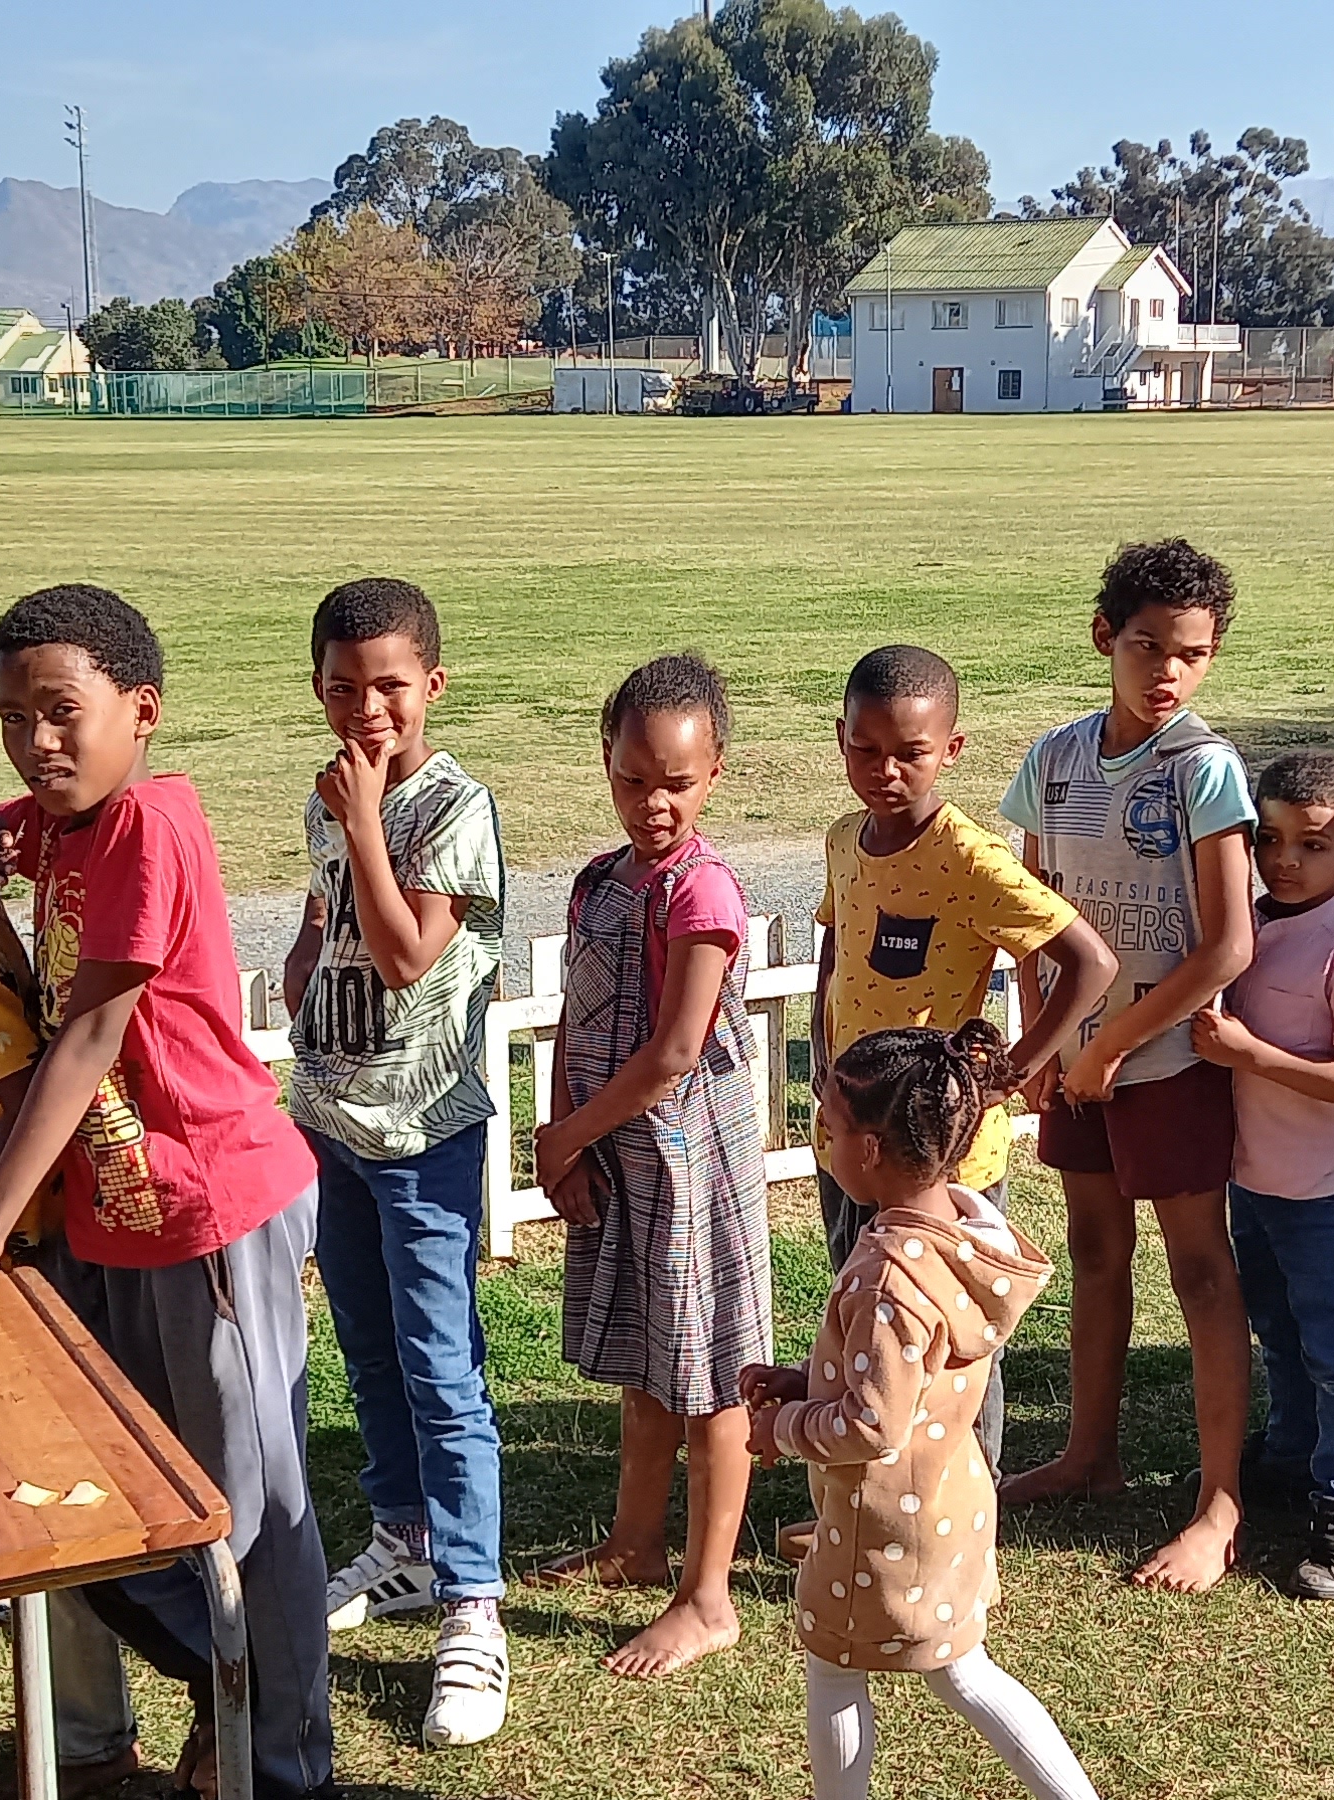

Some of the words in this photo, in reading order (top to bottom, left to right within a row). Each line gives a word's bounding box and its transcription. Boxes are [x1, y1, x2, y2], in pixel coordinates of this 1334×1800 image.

[1047, 784, 1066, 803] USA
[1076, 876, 1183, 904] EASTSIDE
[880, 936, 919, 950] LTD92
